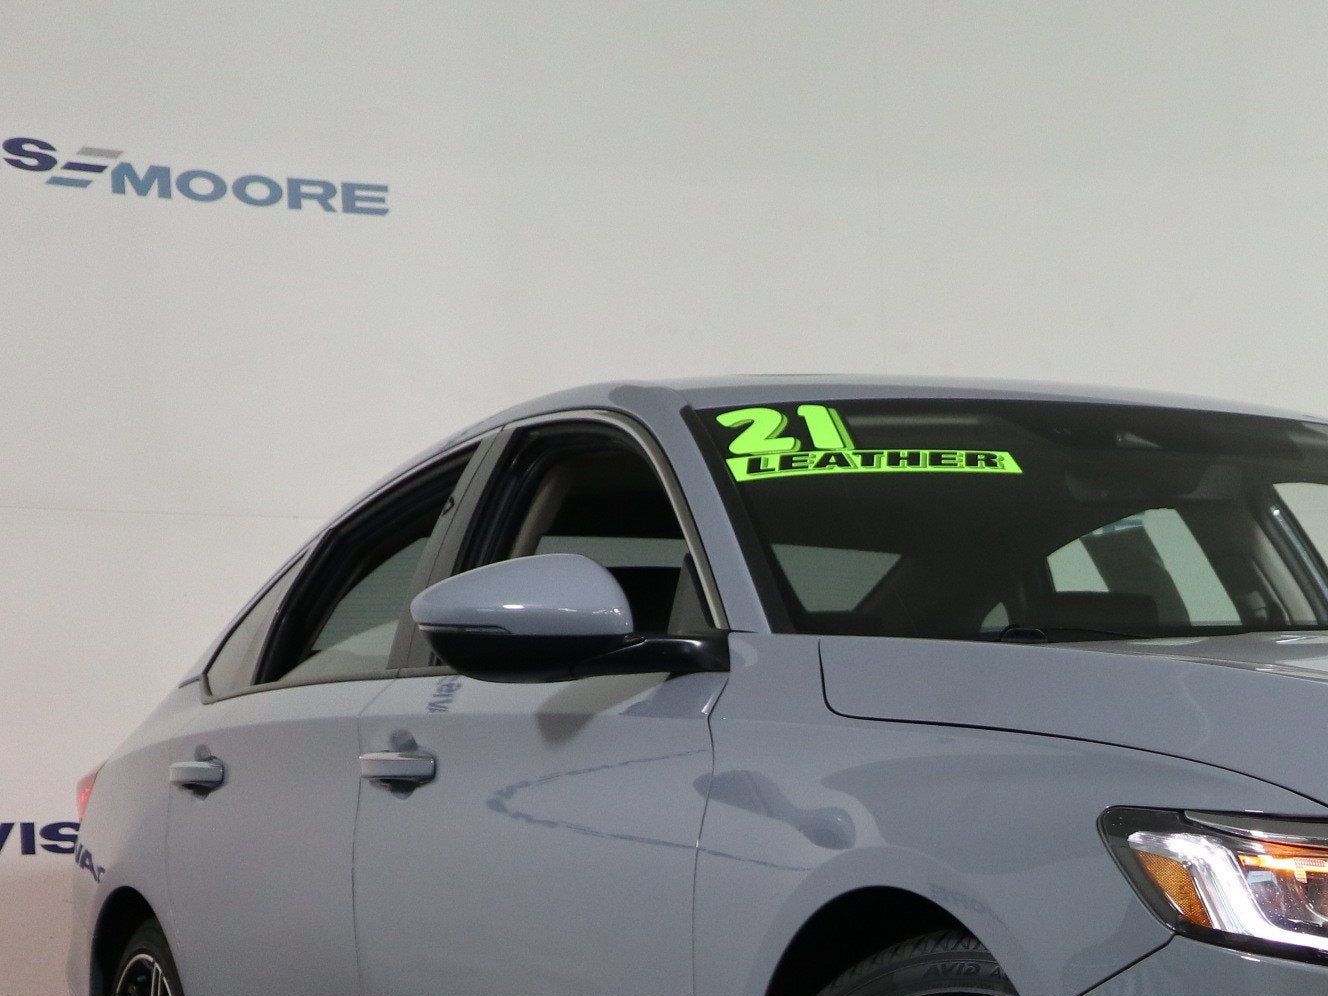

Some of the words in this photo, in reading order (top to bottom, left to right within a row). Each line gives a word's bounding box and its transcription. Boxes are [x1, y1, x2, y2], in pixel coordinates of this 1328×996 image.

[110, 161, 390, 216] MOORE
[716, 404, 855, 455] 21
[746, 450, 1007, 475] LEATHER
